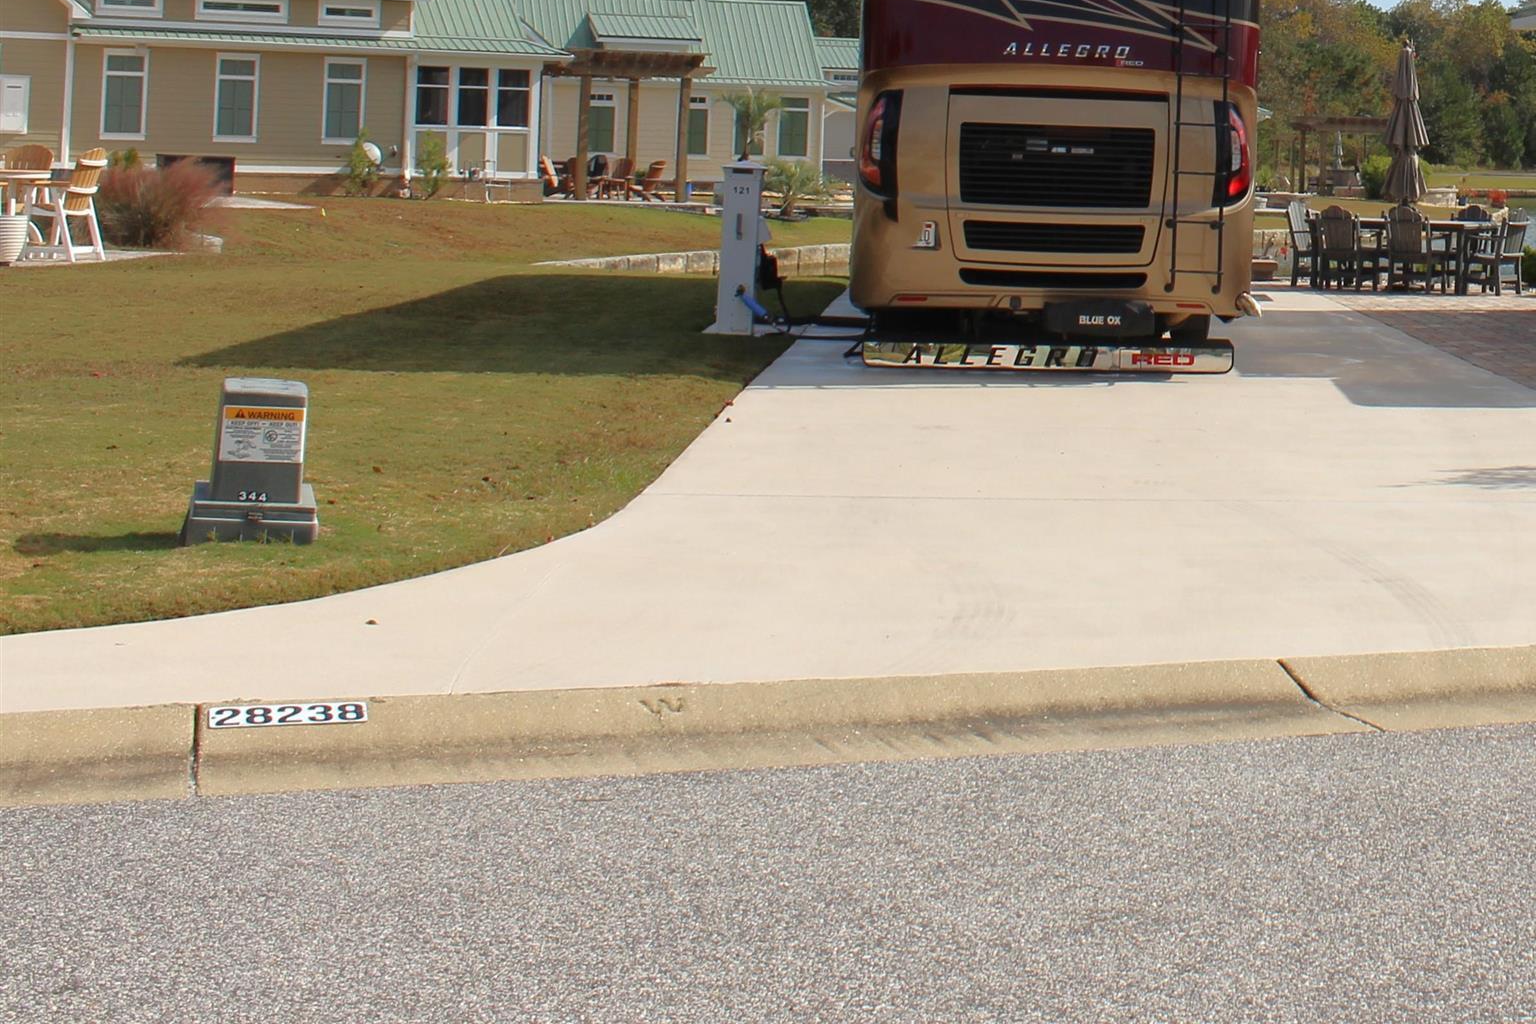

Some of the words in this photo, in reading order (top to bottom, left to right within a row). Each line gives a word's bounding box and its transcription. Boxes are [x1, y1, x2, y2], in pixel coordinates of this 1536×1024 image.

[1003, 42, 1130, 59] ALLEGRO
[733, 186, 750, 195] 121
[1079, 315, 1104, 325] BLUE
[1107, 316, 1121, 325] OX
[902, 346, 1099, 367] ALLEGRO
[1132, 353, 1195, 366] RED
[247, 410, 295, 420] WARNING
[239, 491, 267, 502] 344
[214, 703, 365, 727] 28238
